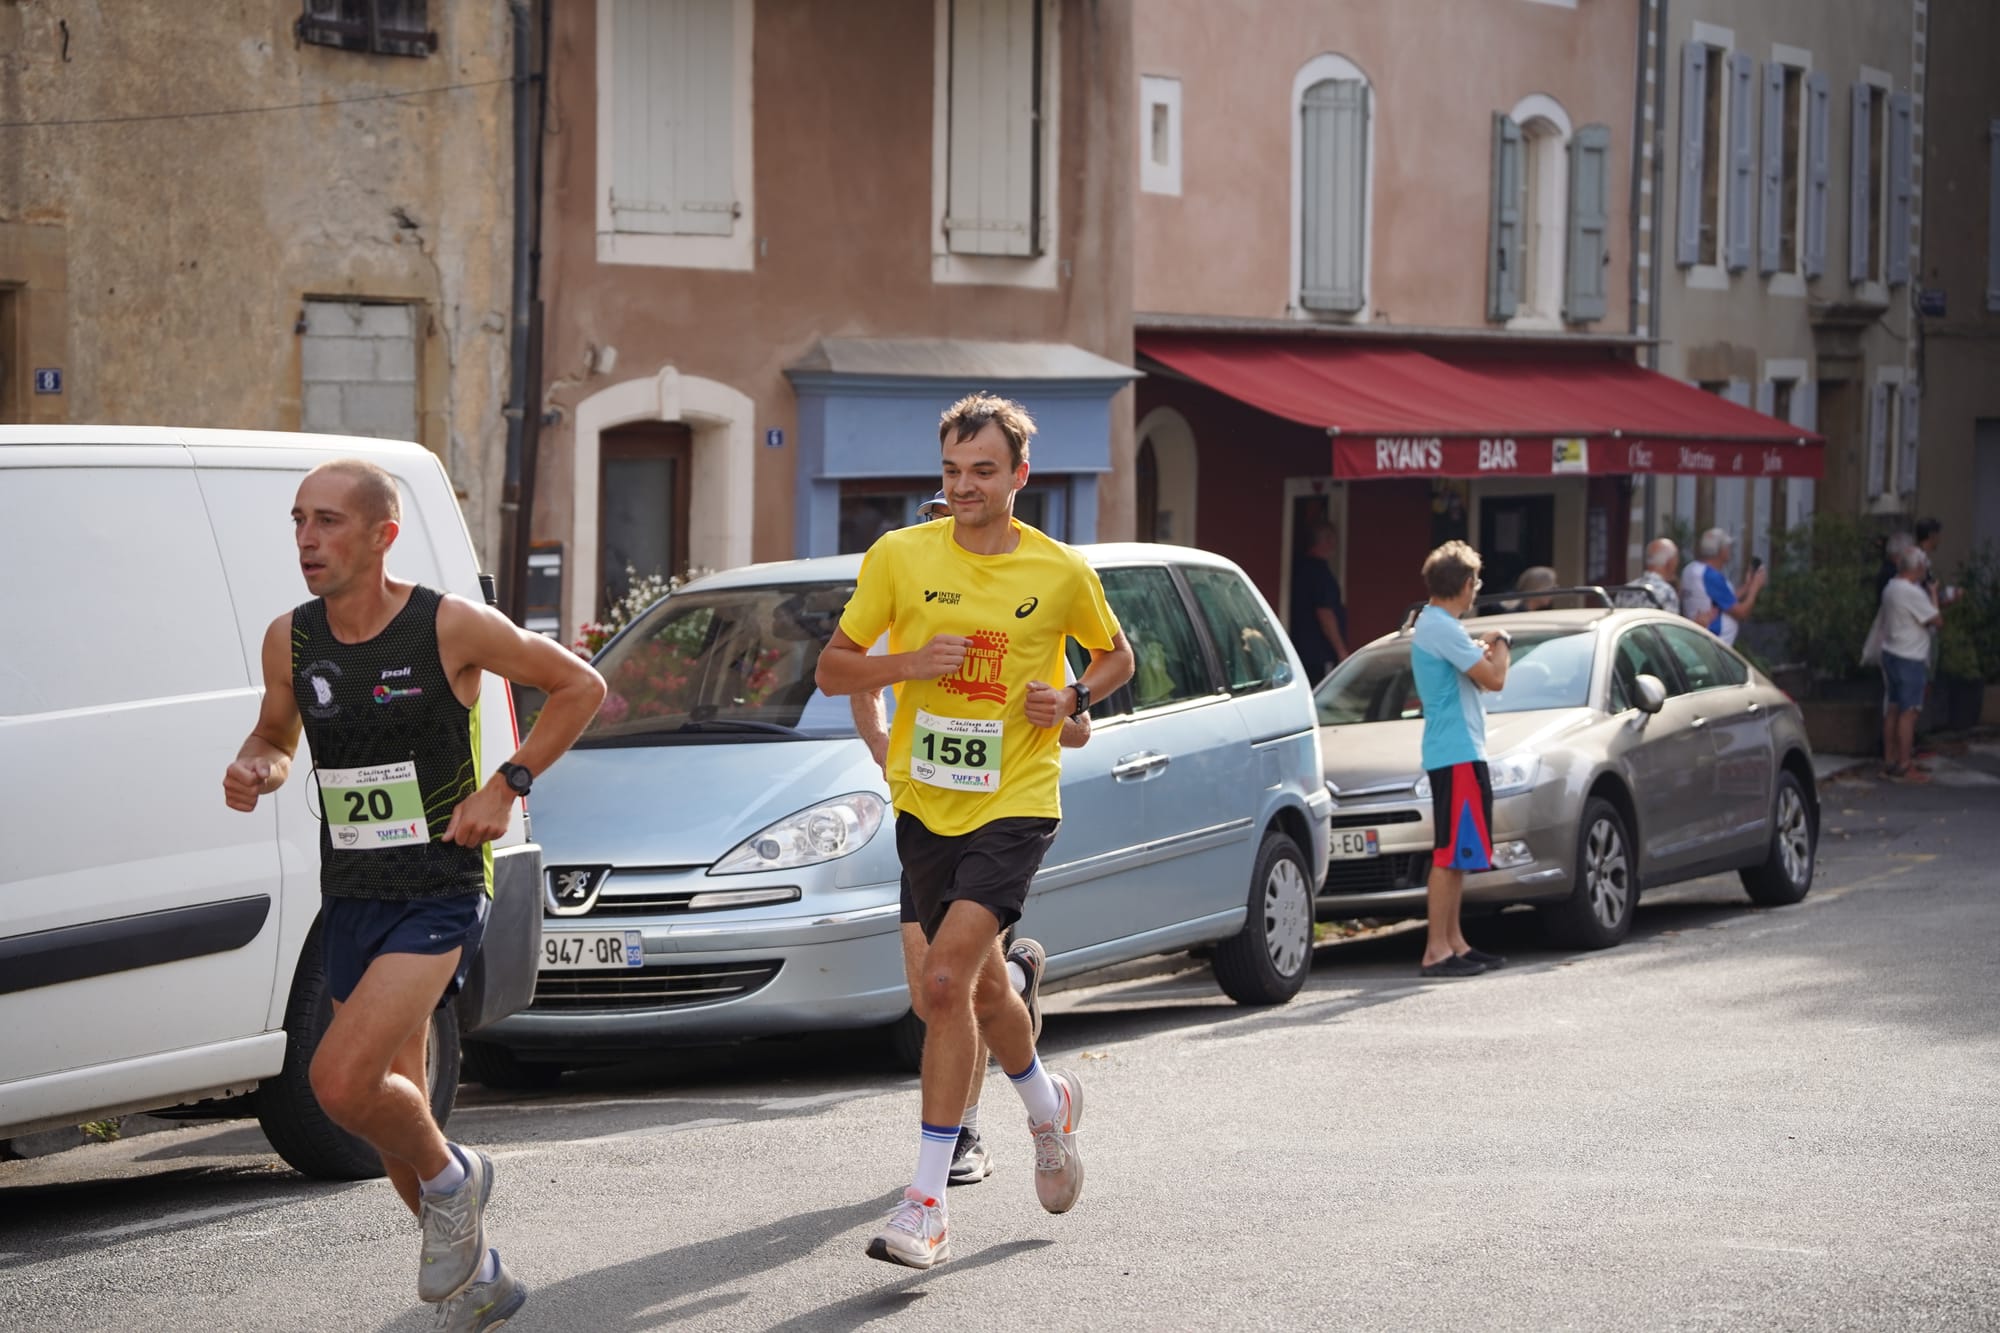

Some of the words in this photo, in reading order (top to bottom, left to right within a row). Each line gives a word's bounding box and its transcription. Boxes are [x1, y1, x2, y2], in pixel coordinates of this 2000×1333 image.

[44, 371, 54, 389] 8
[1376, 437, 1442, 471] RYAN'S
[1478, 438, 1517, 470] BAR
[937, 591, 961, 600] INTER
[937, 597, 960, 606] SPORT
[922, 732, 987, 767] 158
[951, 773, 981, 782] TUFF'S
[344, 788, 393, 822] 20
